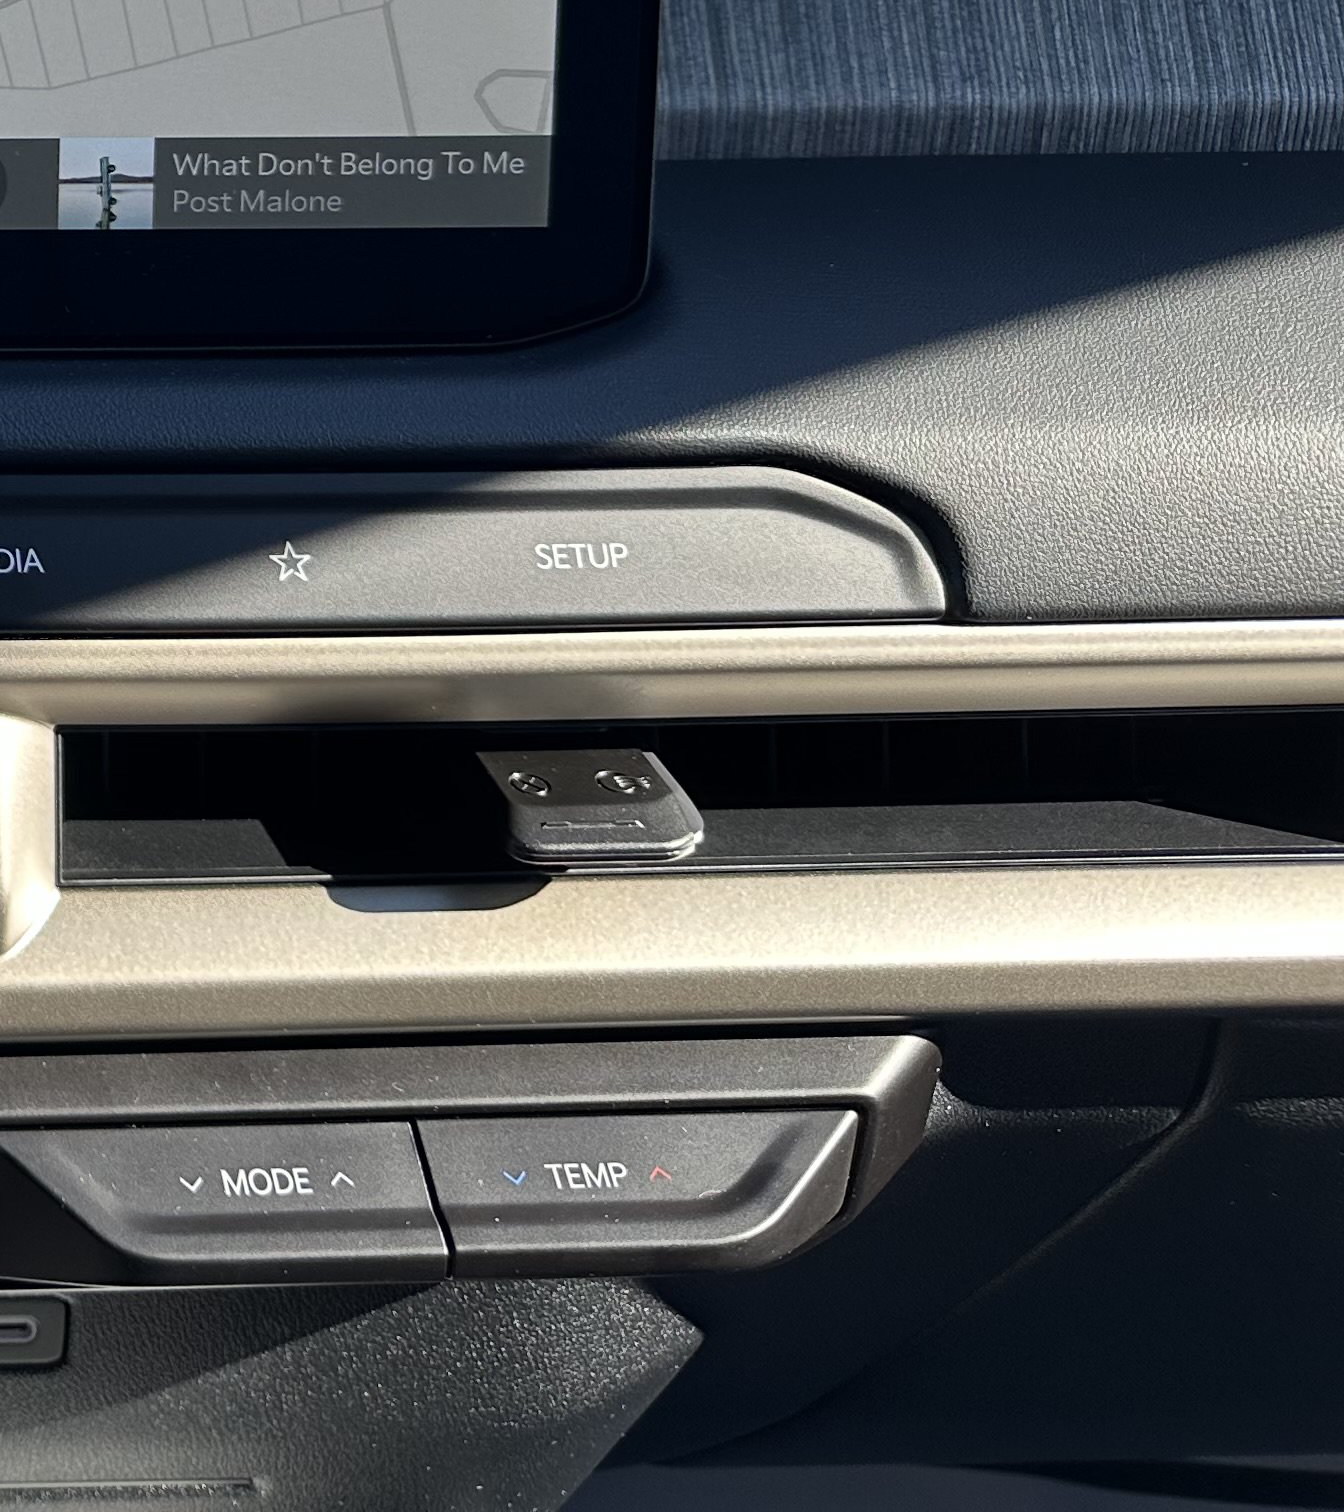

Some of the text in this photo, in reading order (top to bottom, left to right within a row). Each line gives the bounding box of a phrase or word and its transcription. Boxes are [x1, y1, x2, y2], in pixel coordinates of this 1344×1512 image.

[173, 151, 526, 181] What Don't Belong To Me
[173, 189, 344, 214] Post Malone
[533, 541, 629, 570] SETUP
[221, 1167, 314, 1197] MODE
[543, 1162, 629, 1190] TEMP
